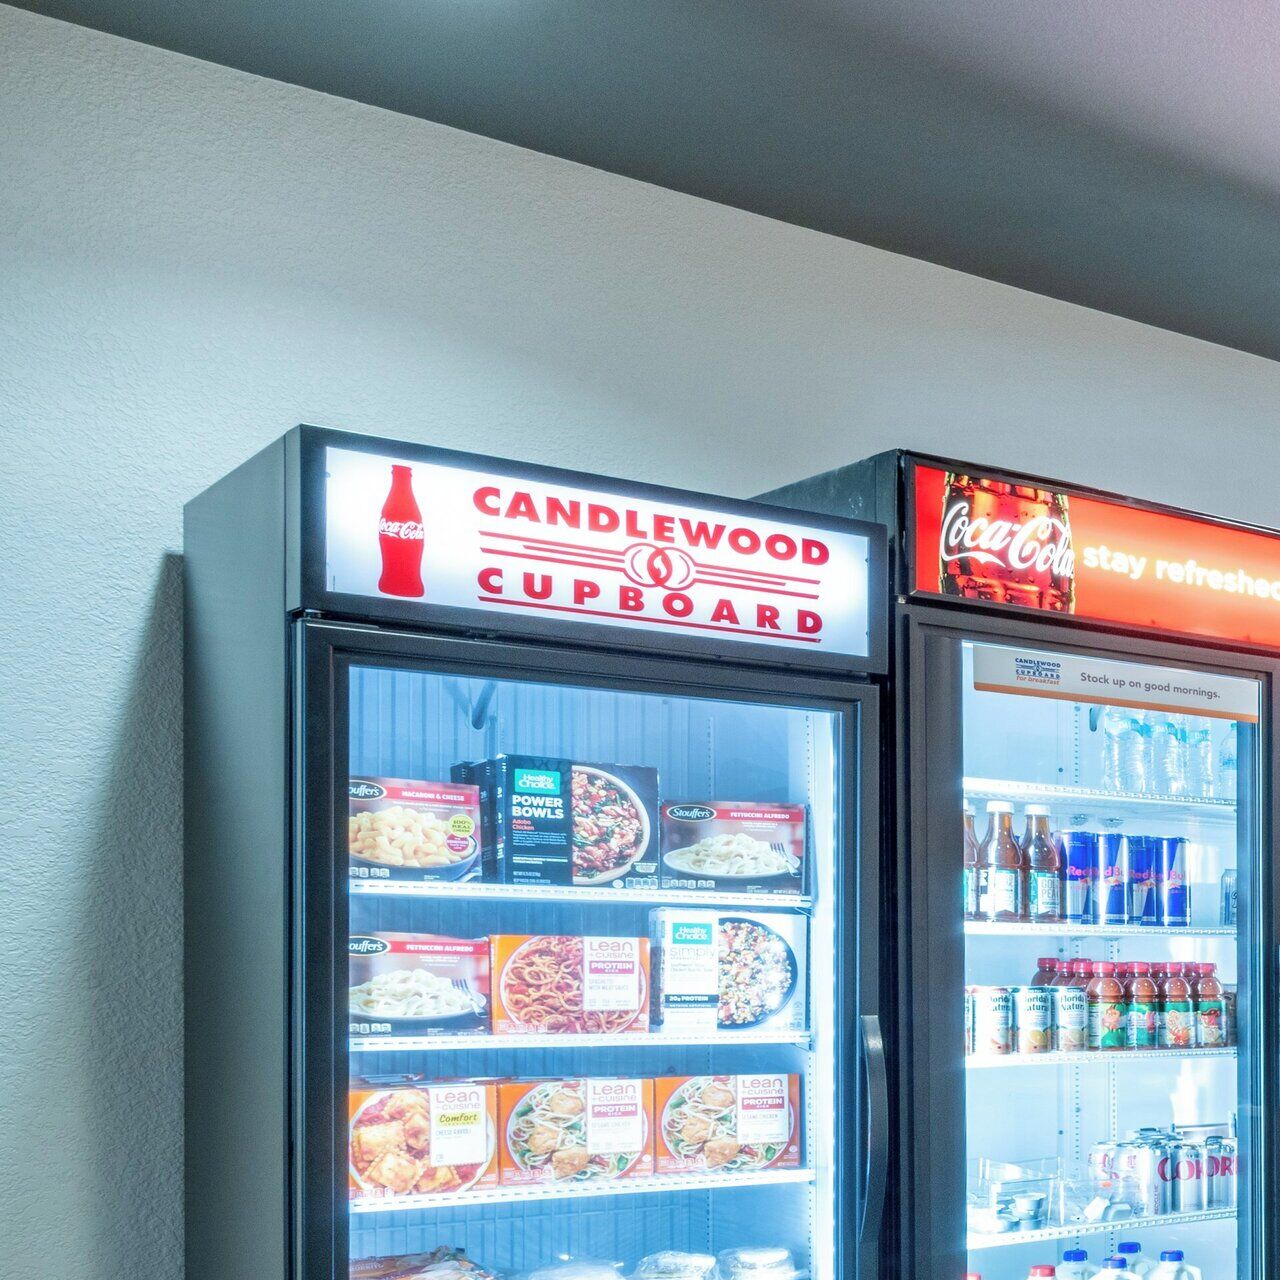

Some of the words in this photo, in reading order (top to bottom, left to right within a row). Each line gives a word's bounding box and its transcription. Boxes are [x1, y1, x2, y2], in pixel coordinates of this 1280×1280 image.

[473, 486, 830, 567] CANDLEWOOD
[941, 501, 1074, 579] Coca-Cola
[1083, 543, 1146, 580] stay
[477, 567, 824, 635] CUPBOARD
[1015, 657, 1062, 668] CANDLEWOOD
[1015, 669, 1061, 679] CUPBOARD
[1028, 677, 1061, 685] breakfast
[1080, 671, 1110, 685] Stock
[1112, 678, 1126, 688] up
[1144, 682, 1170, 693] good
[1172, 685, 1221, 699] mornings.
[512, 795, 563, 808] POWER
[512, 806, 564, 819] BOWLS
[589, 941, 633, 951] Lean
[591, 962, 633, 970] PROTEIN
[741, 1078, 783, 1088] Lean
[592, 1084, 636, 1095] Lean
[436, 1090, 480, 1103] Lean
[743, 1097, 783, 1105] PROTEIN
[593, 1105, 636, 1113] PROTEIN
[439, 1112, 478, 1123] Comfort
